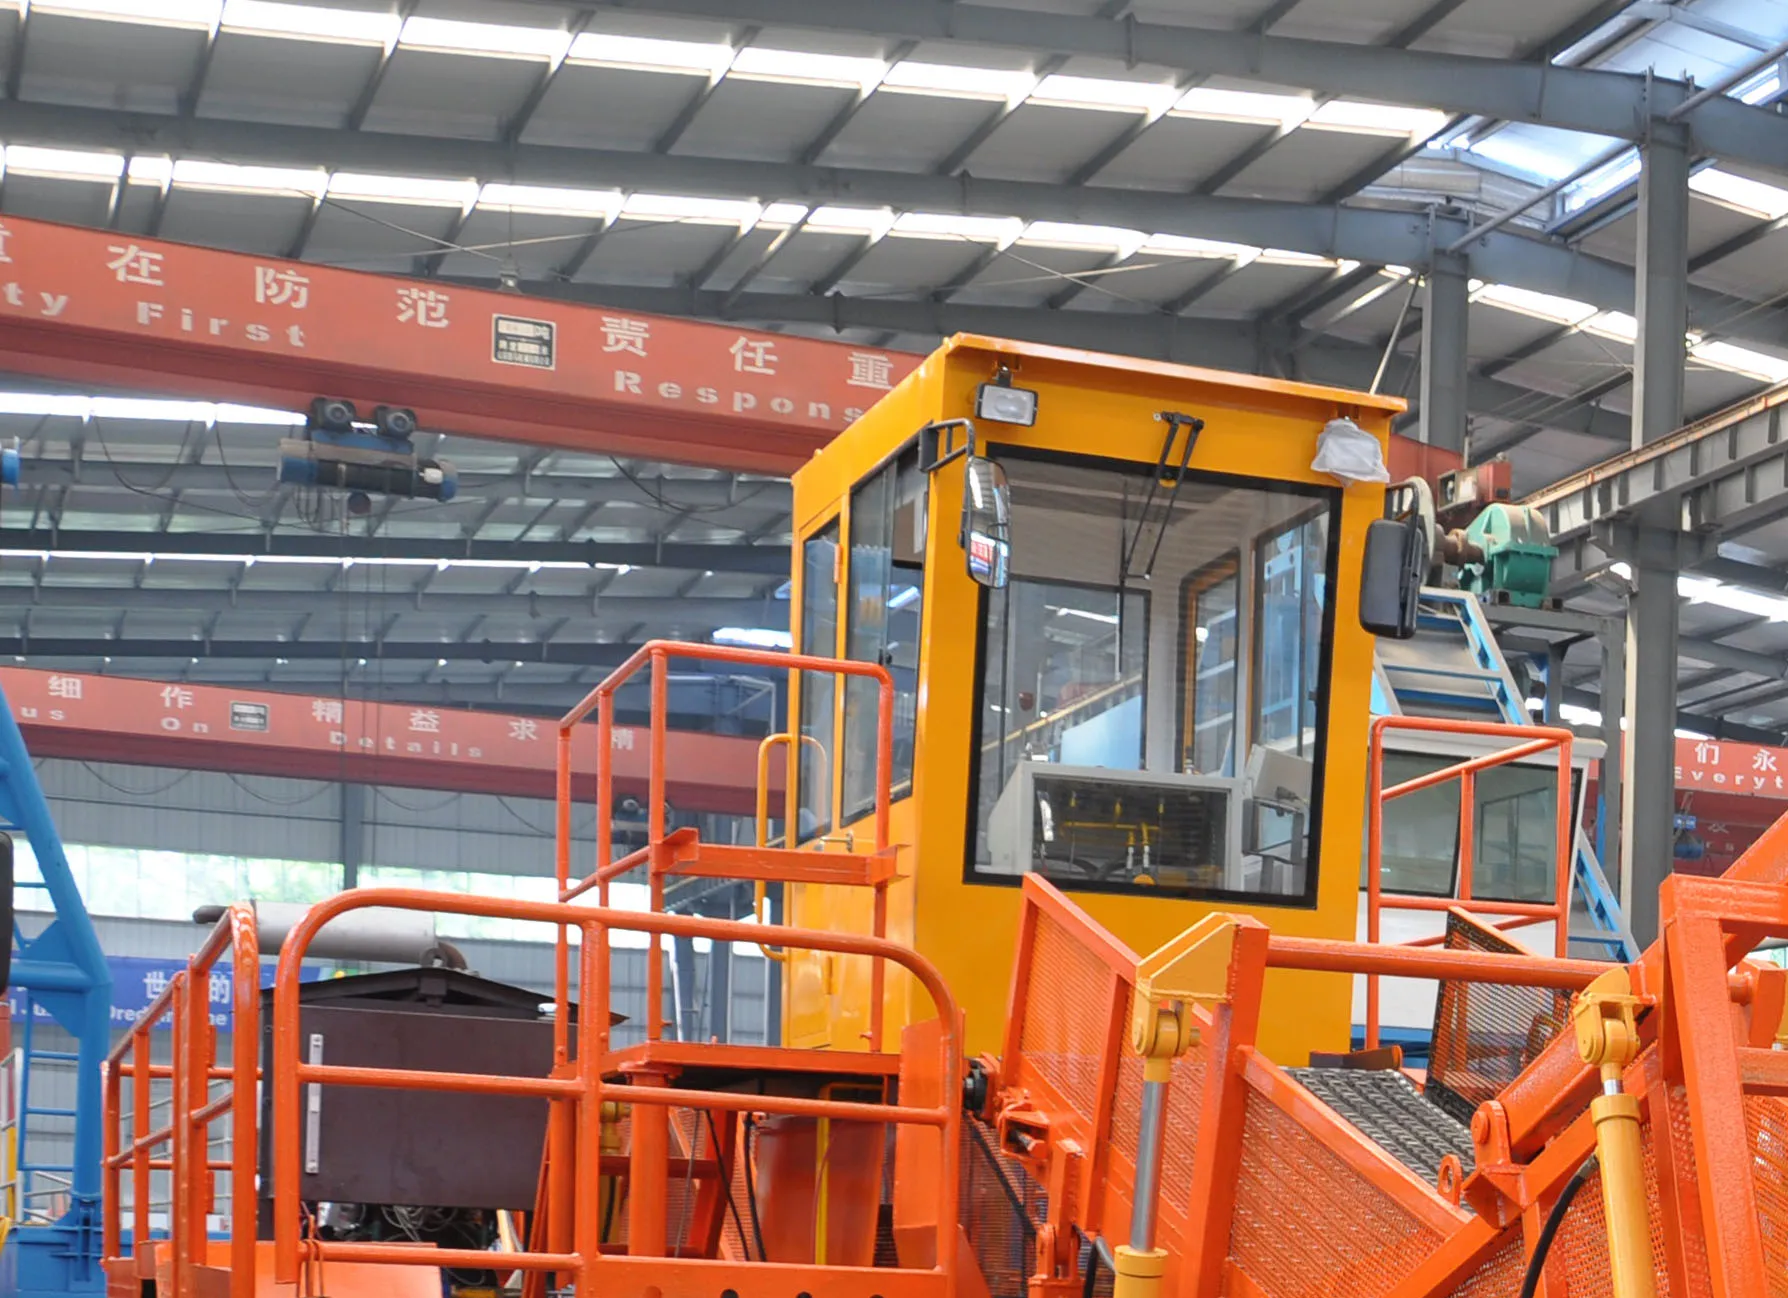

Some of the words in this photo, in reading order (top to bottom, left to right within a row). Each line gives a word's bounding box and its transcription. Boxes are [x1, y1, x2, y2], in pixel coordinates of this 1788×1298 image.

[137, 301, 305, 347] First
[161, 717, 209, 734] On
[329, 731, 483, 757] Details
